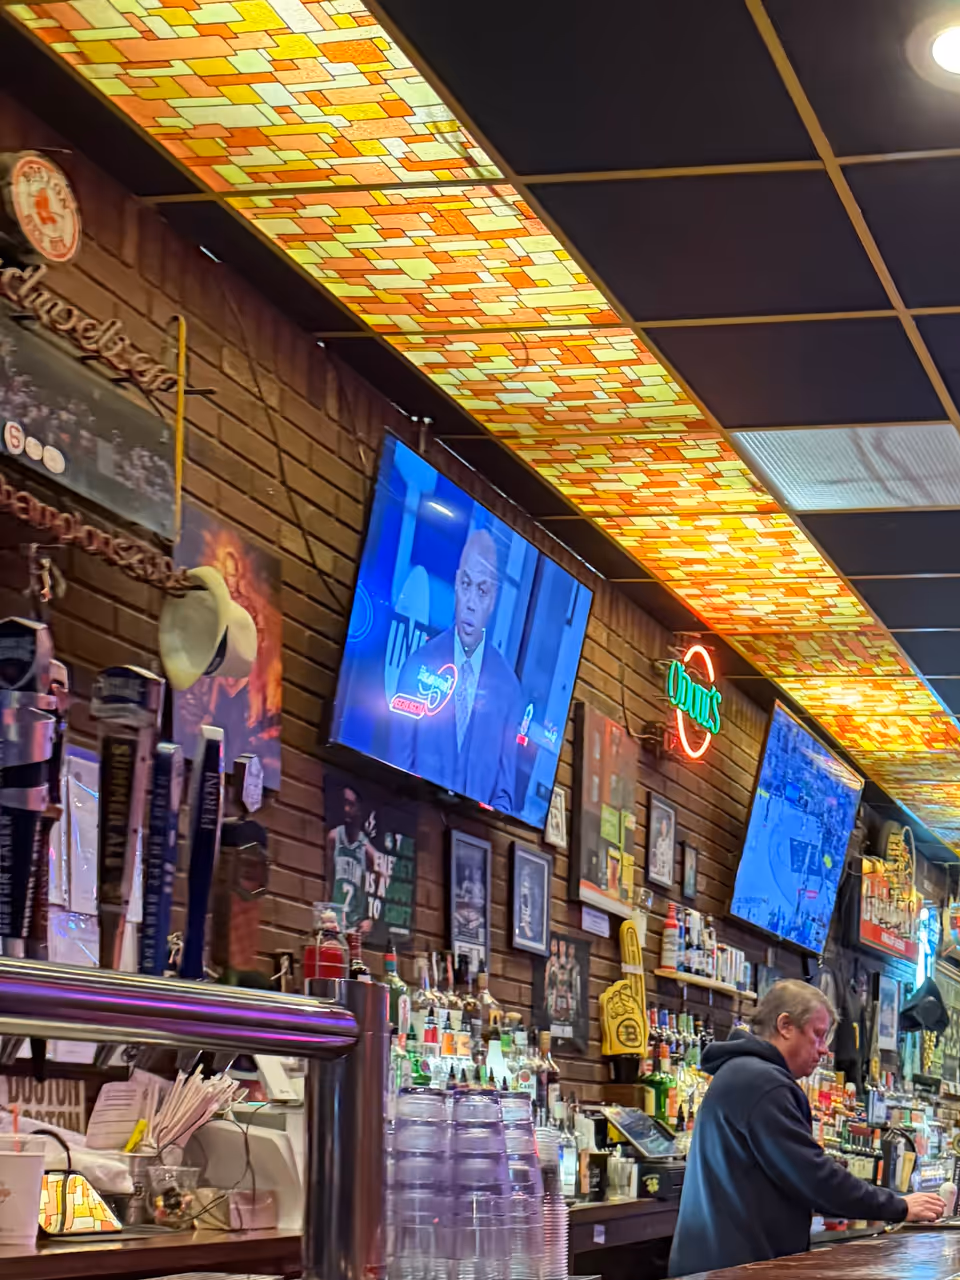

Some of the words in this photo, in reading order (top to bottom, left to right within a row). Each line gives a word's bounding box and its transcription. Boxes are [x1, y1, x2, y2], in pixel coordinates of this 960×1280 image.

[107, 744, 130, 825] SUMMER
[200, 771, 220, 830] PERONI
[341, 881, 355, 912] 7
